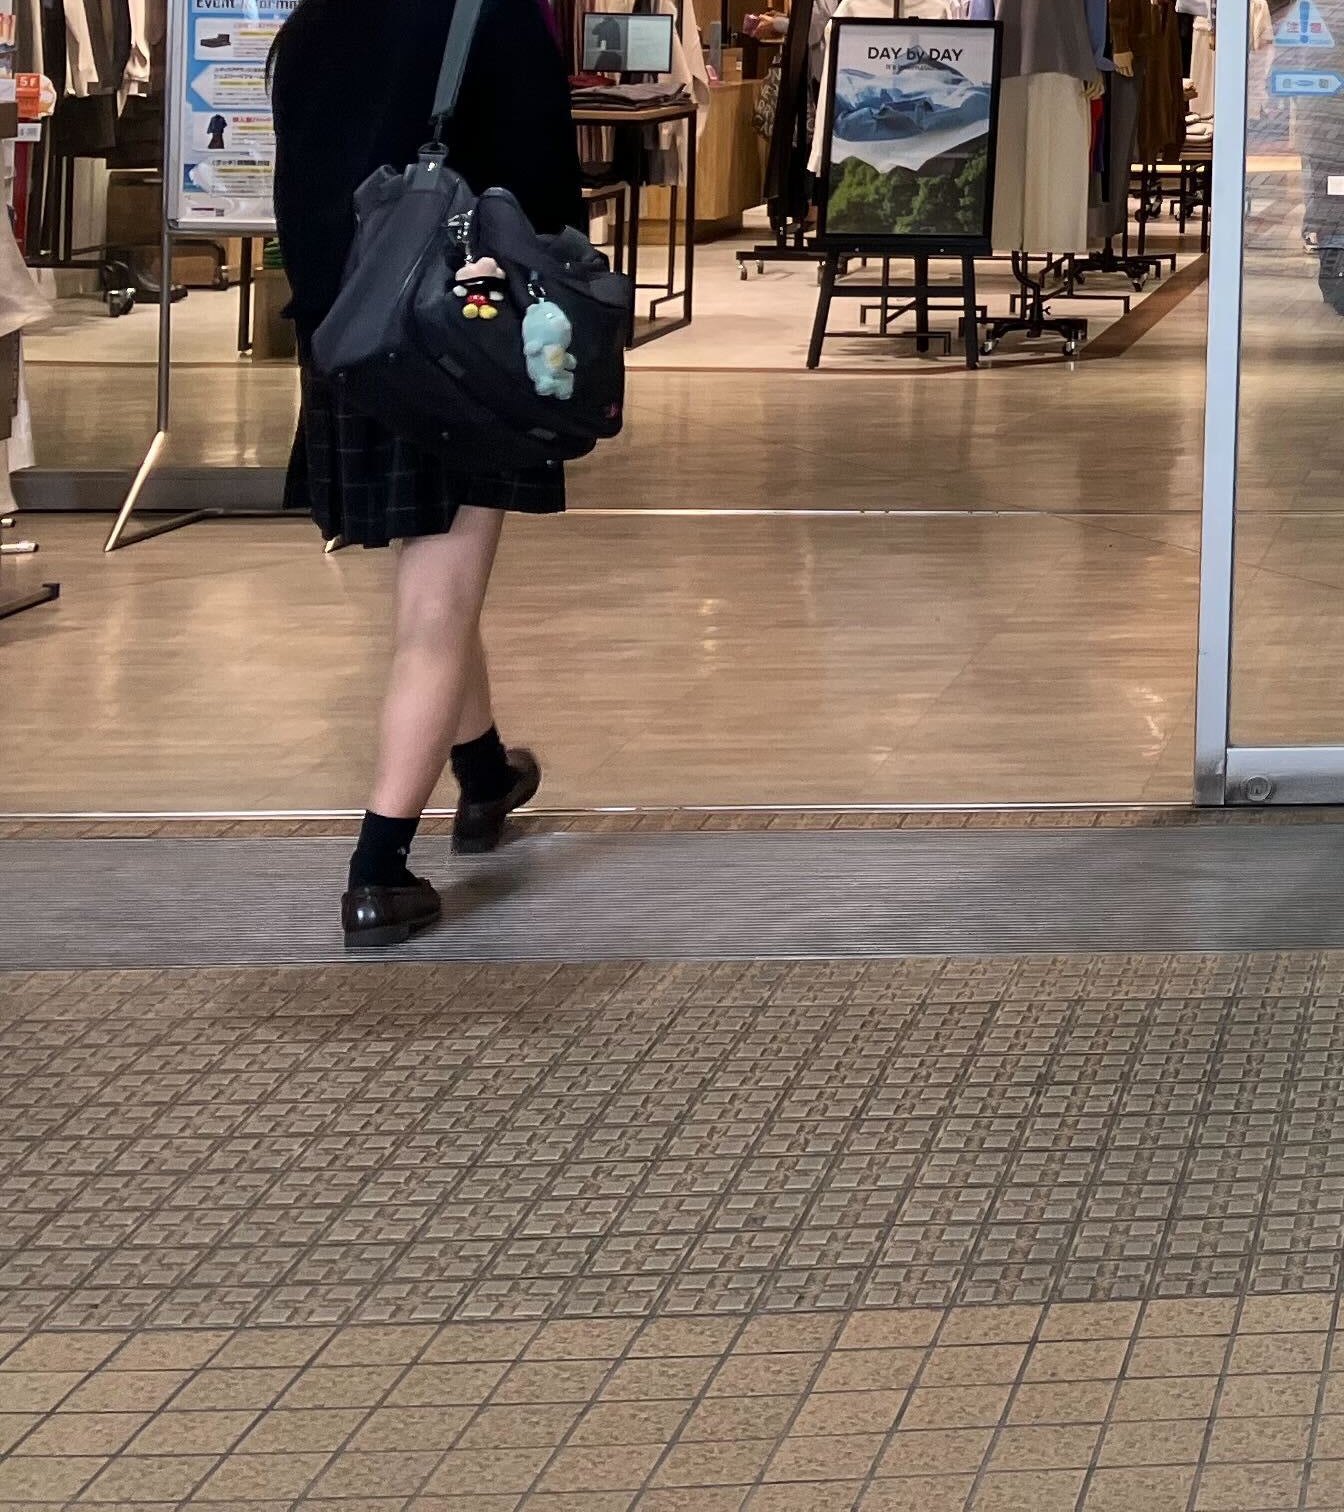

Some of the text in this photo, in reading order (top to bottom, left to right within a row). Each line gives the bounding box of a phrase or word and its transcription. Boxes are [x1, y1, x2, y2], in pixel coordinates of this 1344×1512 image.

[867, 46, 963, 64] DAY by DAY
